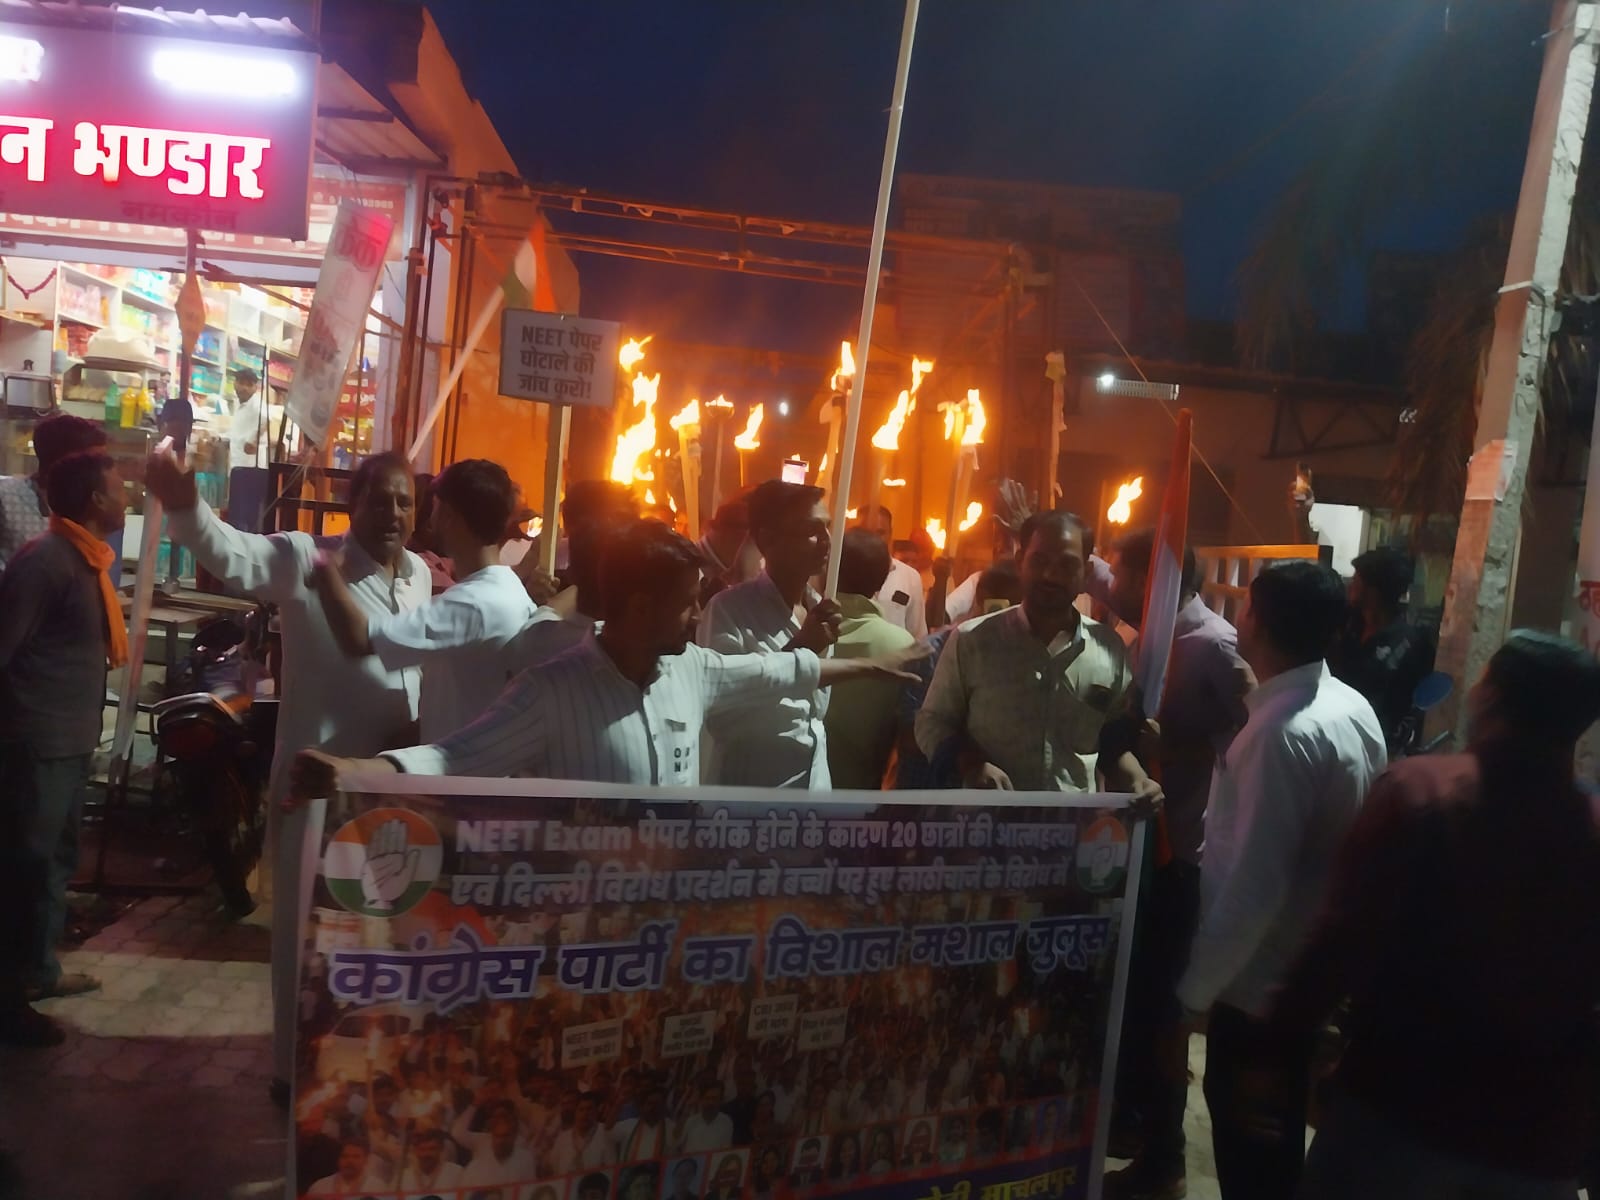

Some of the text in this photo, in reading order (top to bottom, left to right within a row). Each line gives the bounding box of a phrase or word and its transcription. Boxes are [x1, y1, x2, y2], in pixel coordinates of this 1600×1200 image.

[73, 121, 271, 200] भण्डार
[521, 326, 566, 347] NEET
[518, 371, 549, 393] जांच
[519, 345, 597, 375] घोटाले की
[456, 809, 1076, 854] NEET Exam पेपर लीक होने के कारण 20 छात्रों की आत्महत्या
[451, 864, 499, 906] एवं
[501, 861, 593, 907] दिल्ली
[594, 860, 673, 904] विरोध
[674, 858, 756, 901] प्रदर्शन
[783, 857, 839, 895] बच्चों
[837, 866, 866, 895] पर
[866, 866, 895, 906] हुए
[983, 856, 1005, 889] के
[1005, 855, 1051, 889] विरोध
[332, 915, 1112, 1010] कांग्रेस पार्टी का विशाल मशाल जुलूस
